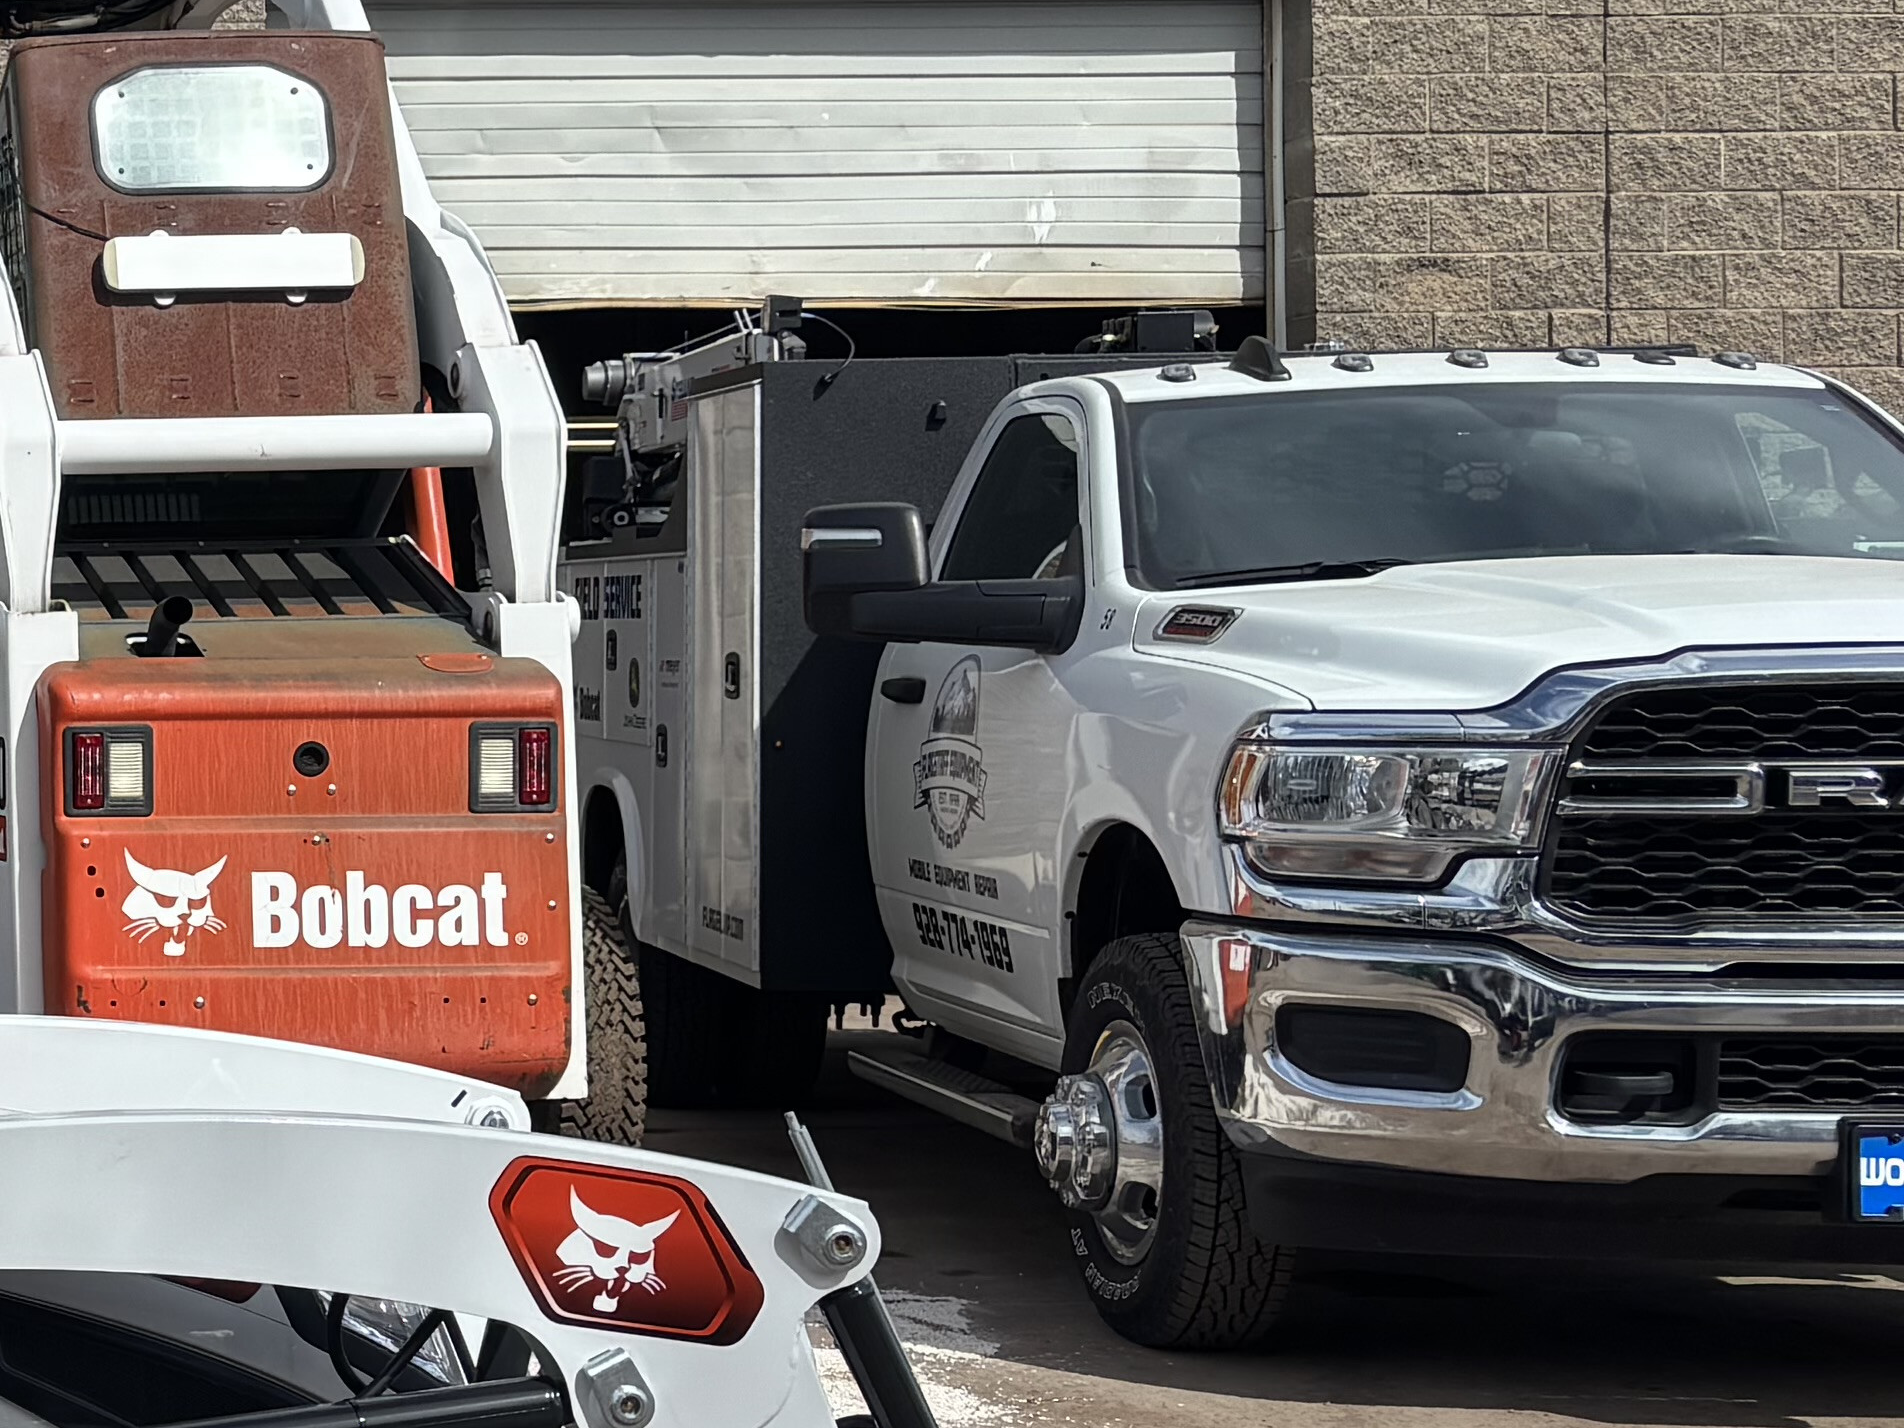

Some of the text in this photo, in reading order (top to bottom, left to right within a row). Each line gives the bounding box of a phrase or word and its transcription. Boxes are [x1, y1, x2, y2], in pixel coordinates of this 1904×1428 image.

[604, 575, 642, 619] SERVICE
[1173, 613, 1223, 627] 3500
[251, 870, 510, 950] Bobcat
[912, 902, 1014, 974] 928-774-1969
